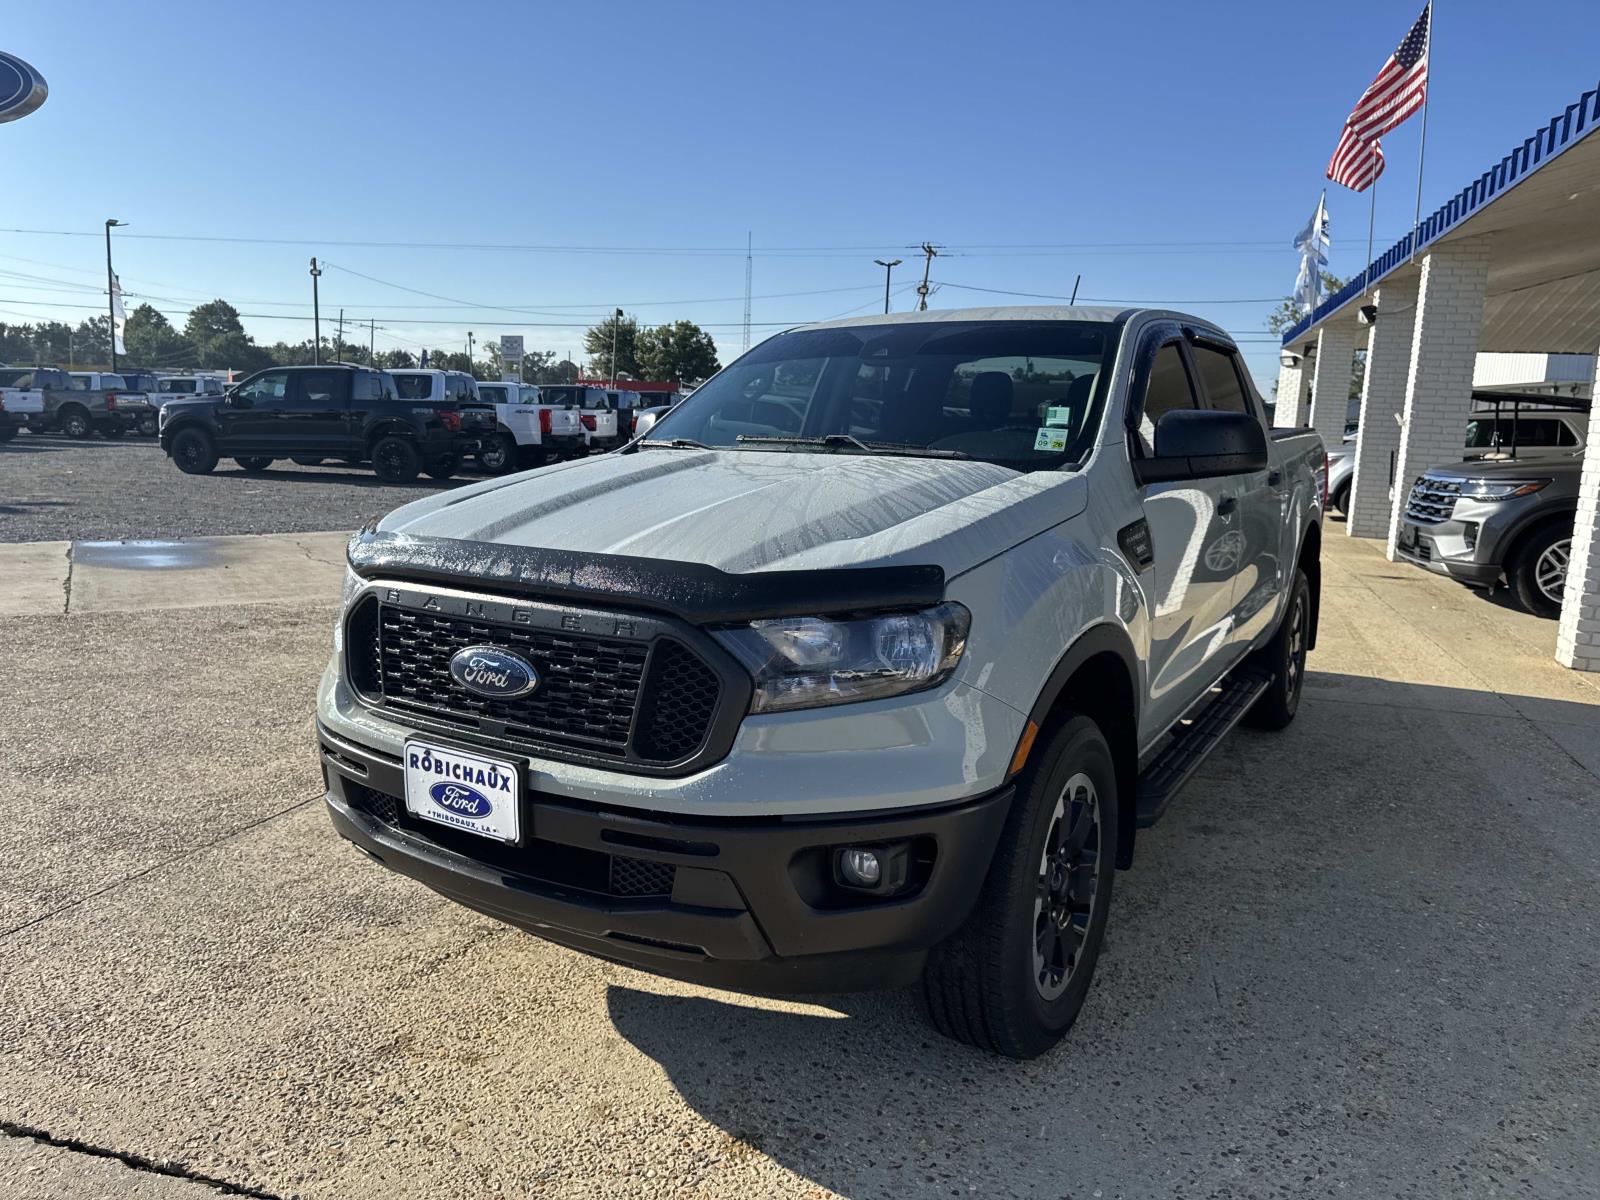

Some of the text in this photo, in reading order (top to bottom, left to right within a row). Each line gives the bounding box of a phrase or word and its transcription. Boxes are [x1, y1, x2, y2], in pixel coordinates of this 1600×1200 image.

[386, 588, 639, 636] RANGER
[463, 657, 510, 689] Ford
[410, 753, 511, 793] ROBICHAUX
[441, 785, 479, 814] Ford
[432, 811, 491, 833] THIBODAUX, LA
